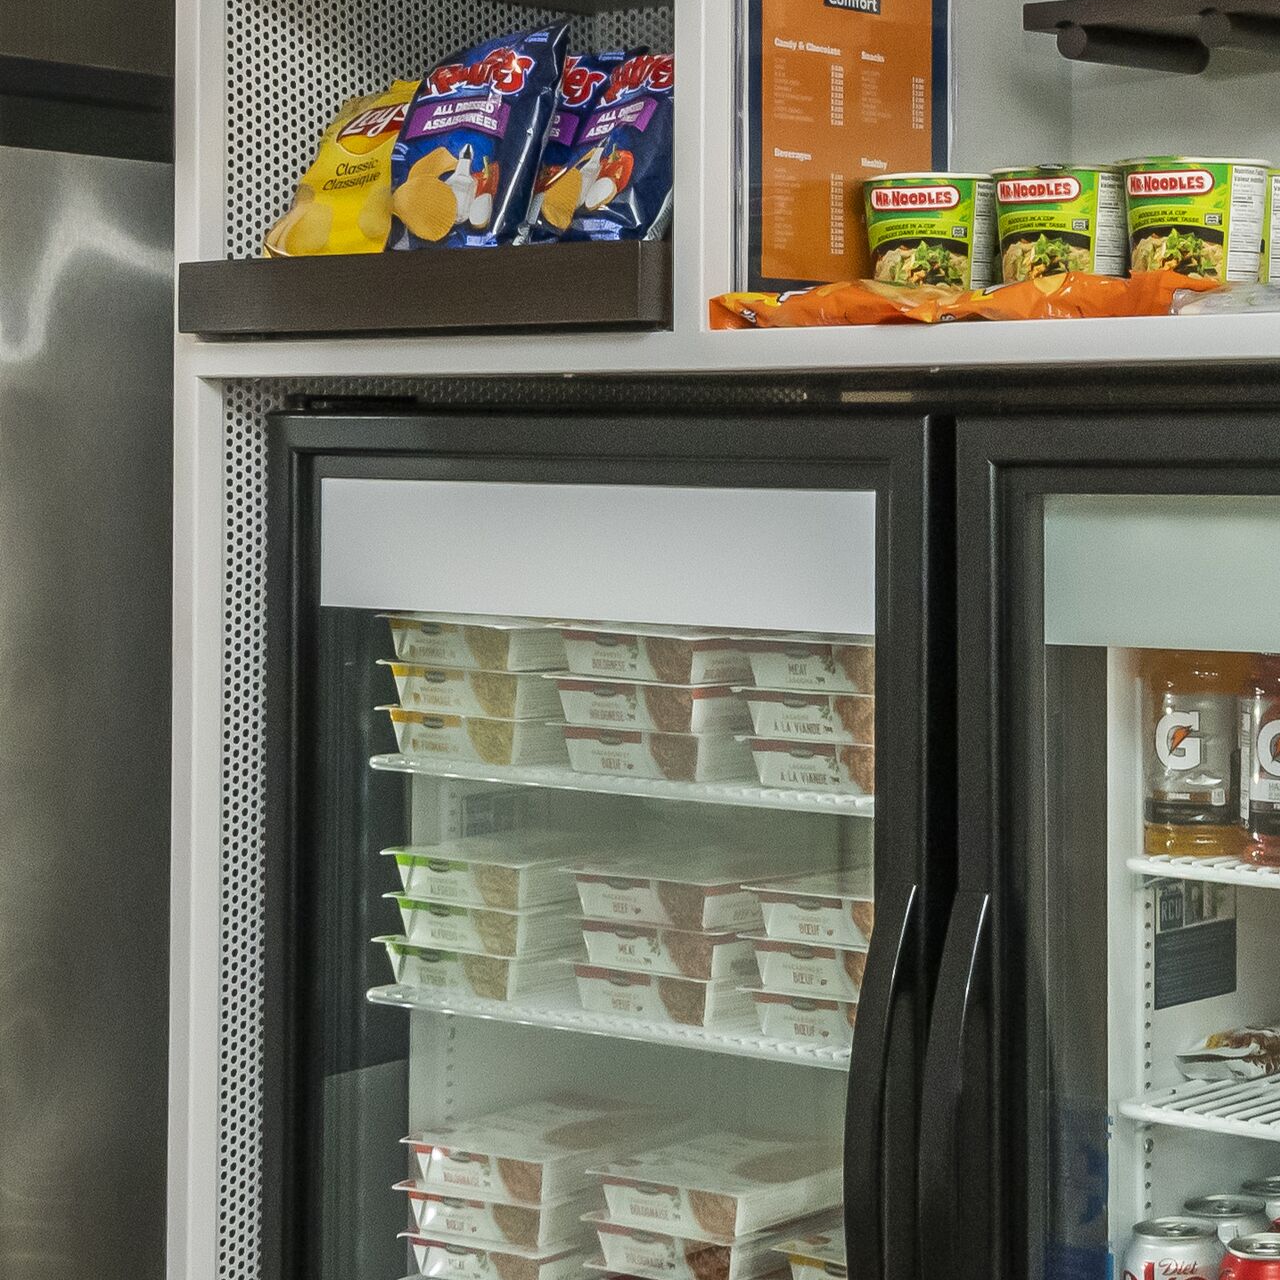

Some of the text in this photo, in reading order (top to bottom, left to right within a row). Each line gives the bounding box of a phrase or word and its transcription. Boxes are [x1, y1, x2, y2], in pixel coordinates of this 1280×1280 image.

[433, 103, 454, 117] ALL
[335, 157, 380, 177] Classic
[322, 172, 382, 191] Classique
[1144, 175, 1205, 193] NOODLES
[892, 190, 953, 207] NOODLES
[1013, 182, 1072, 199] NOODLES
[788, 663, 808, 675] MEAT
[1155, 710, 1201, 770] G
[800, 772, 829, 786] VIANDE
[1159, 1258, 1199, 1278] Diet
